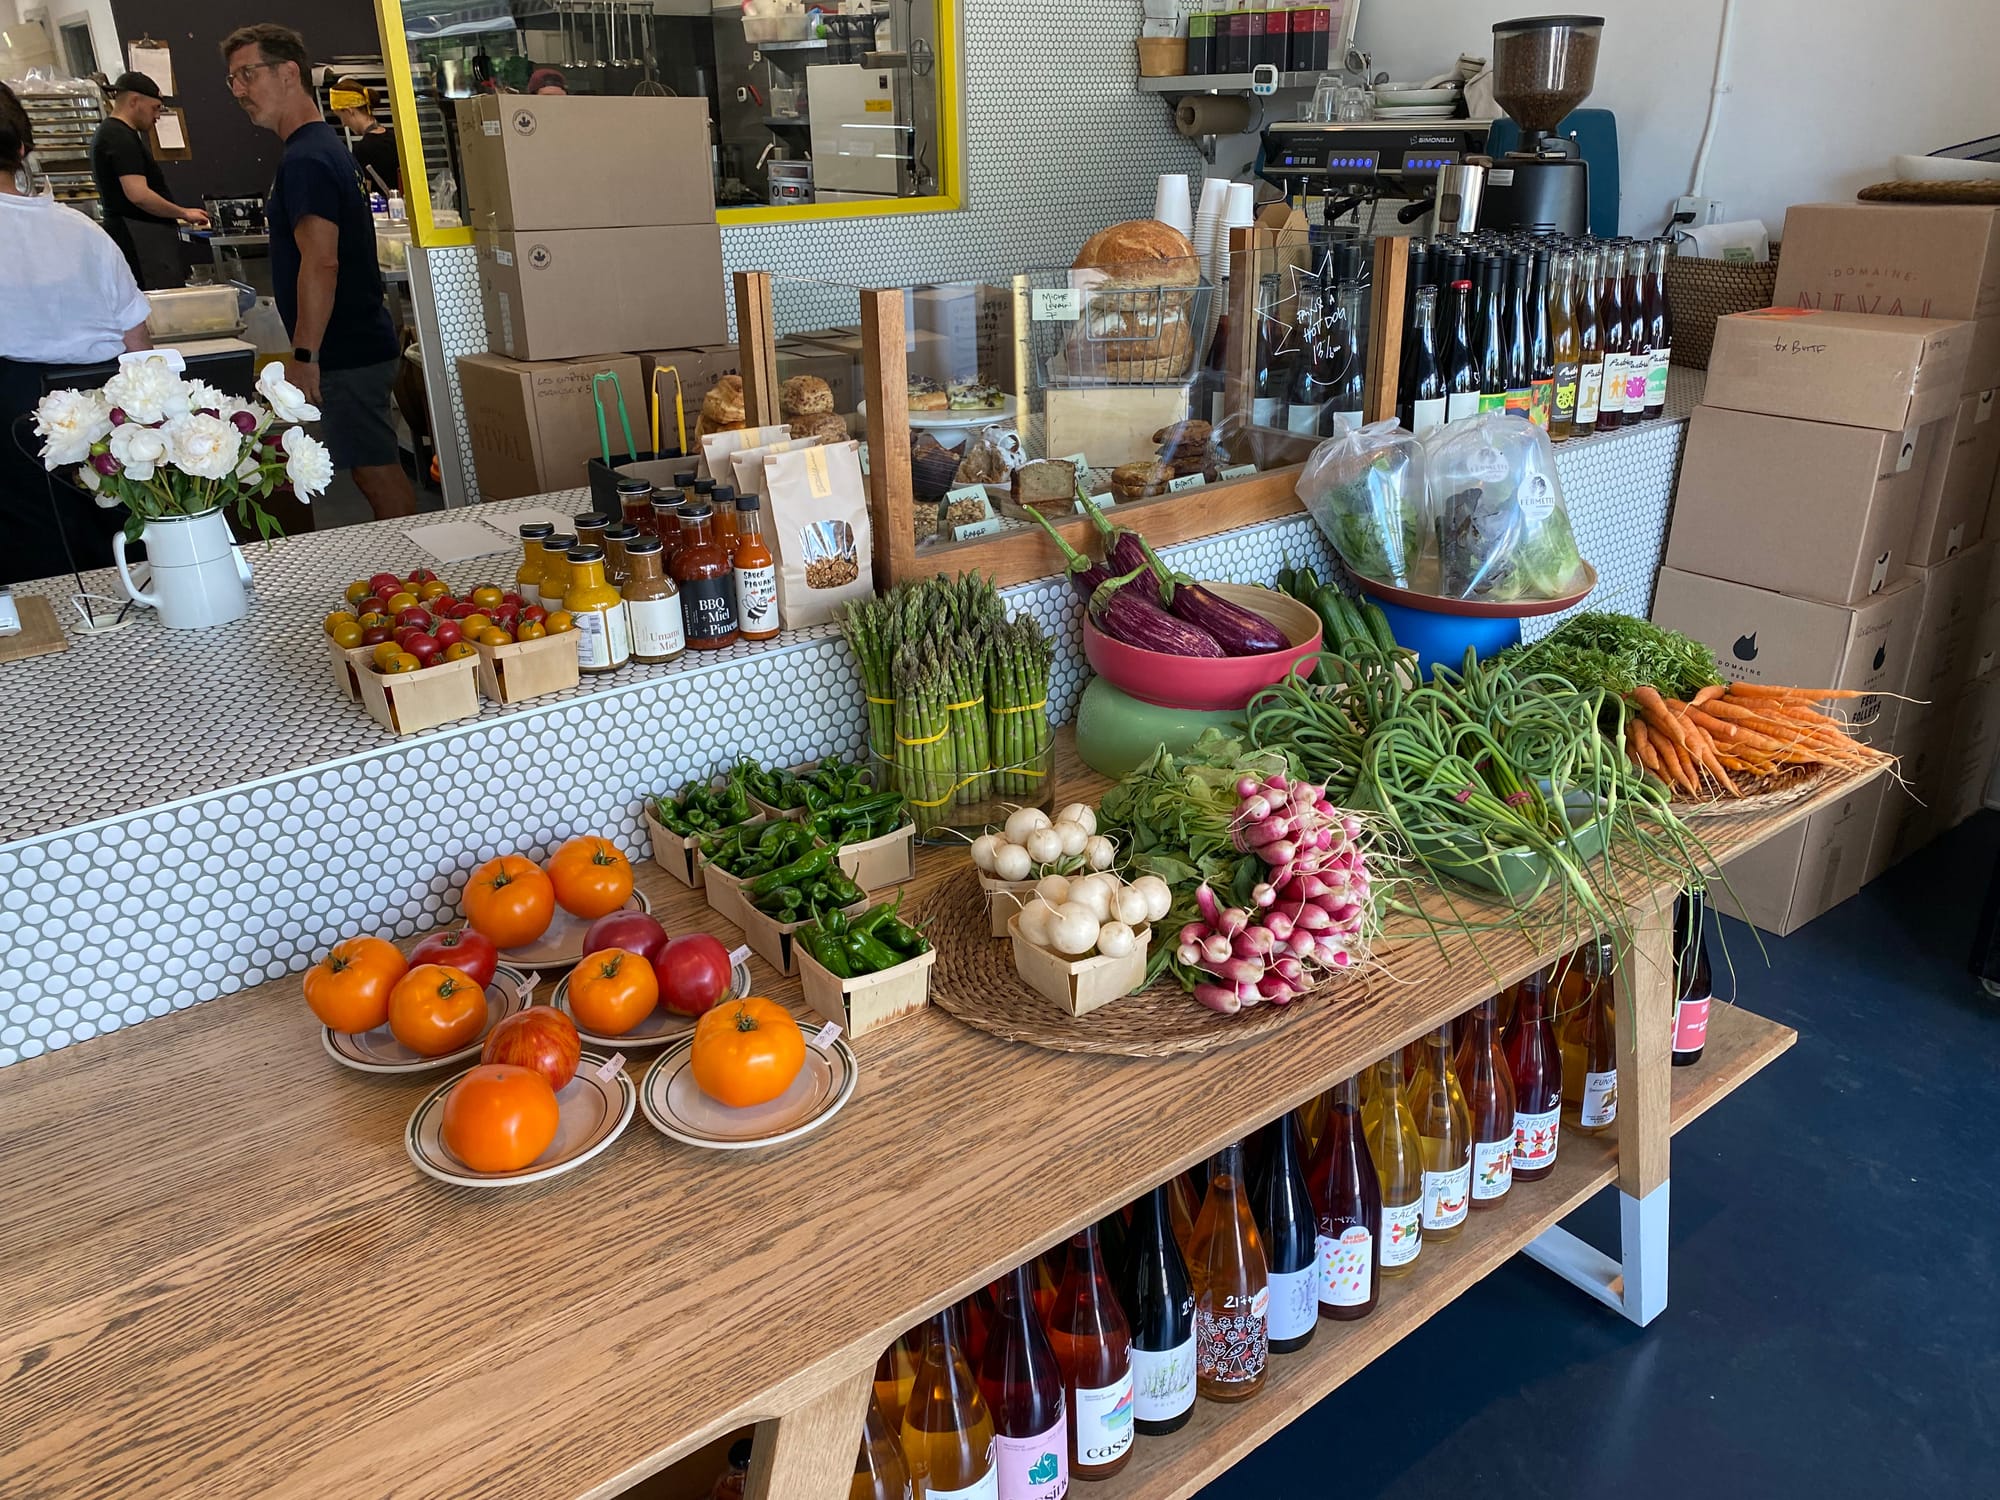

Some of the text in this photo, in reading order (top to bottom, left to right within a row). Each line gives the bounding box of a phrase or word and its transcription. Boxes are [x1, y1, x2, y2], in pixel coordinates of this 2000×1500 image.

[1418, 136, 1456, 144] SIMONELLI
[1833, 267, 1913, 281] DOMAINE
[1303, 319, 1323, 343] HOT
[743, 570, 765, 580] SAUCE
[699, 597, 725, 611] BBQ
[708, 608, 730, 623] Miel
[1717, 660, 1761, 676] DOMAINE
[1852, 700, 1882, 722] FOLLETS
